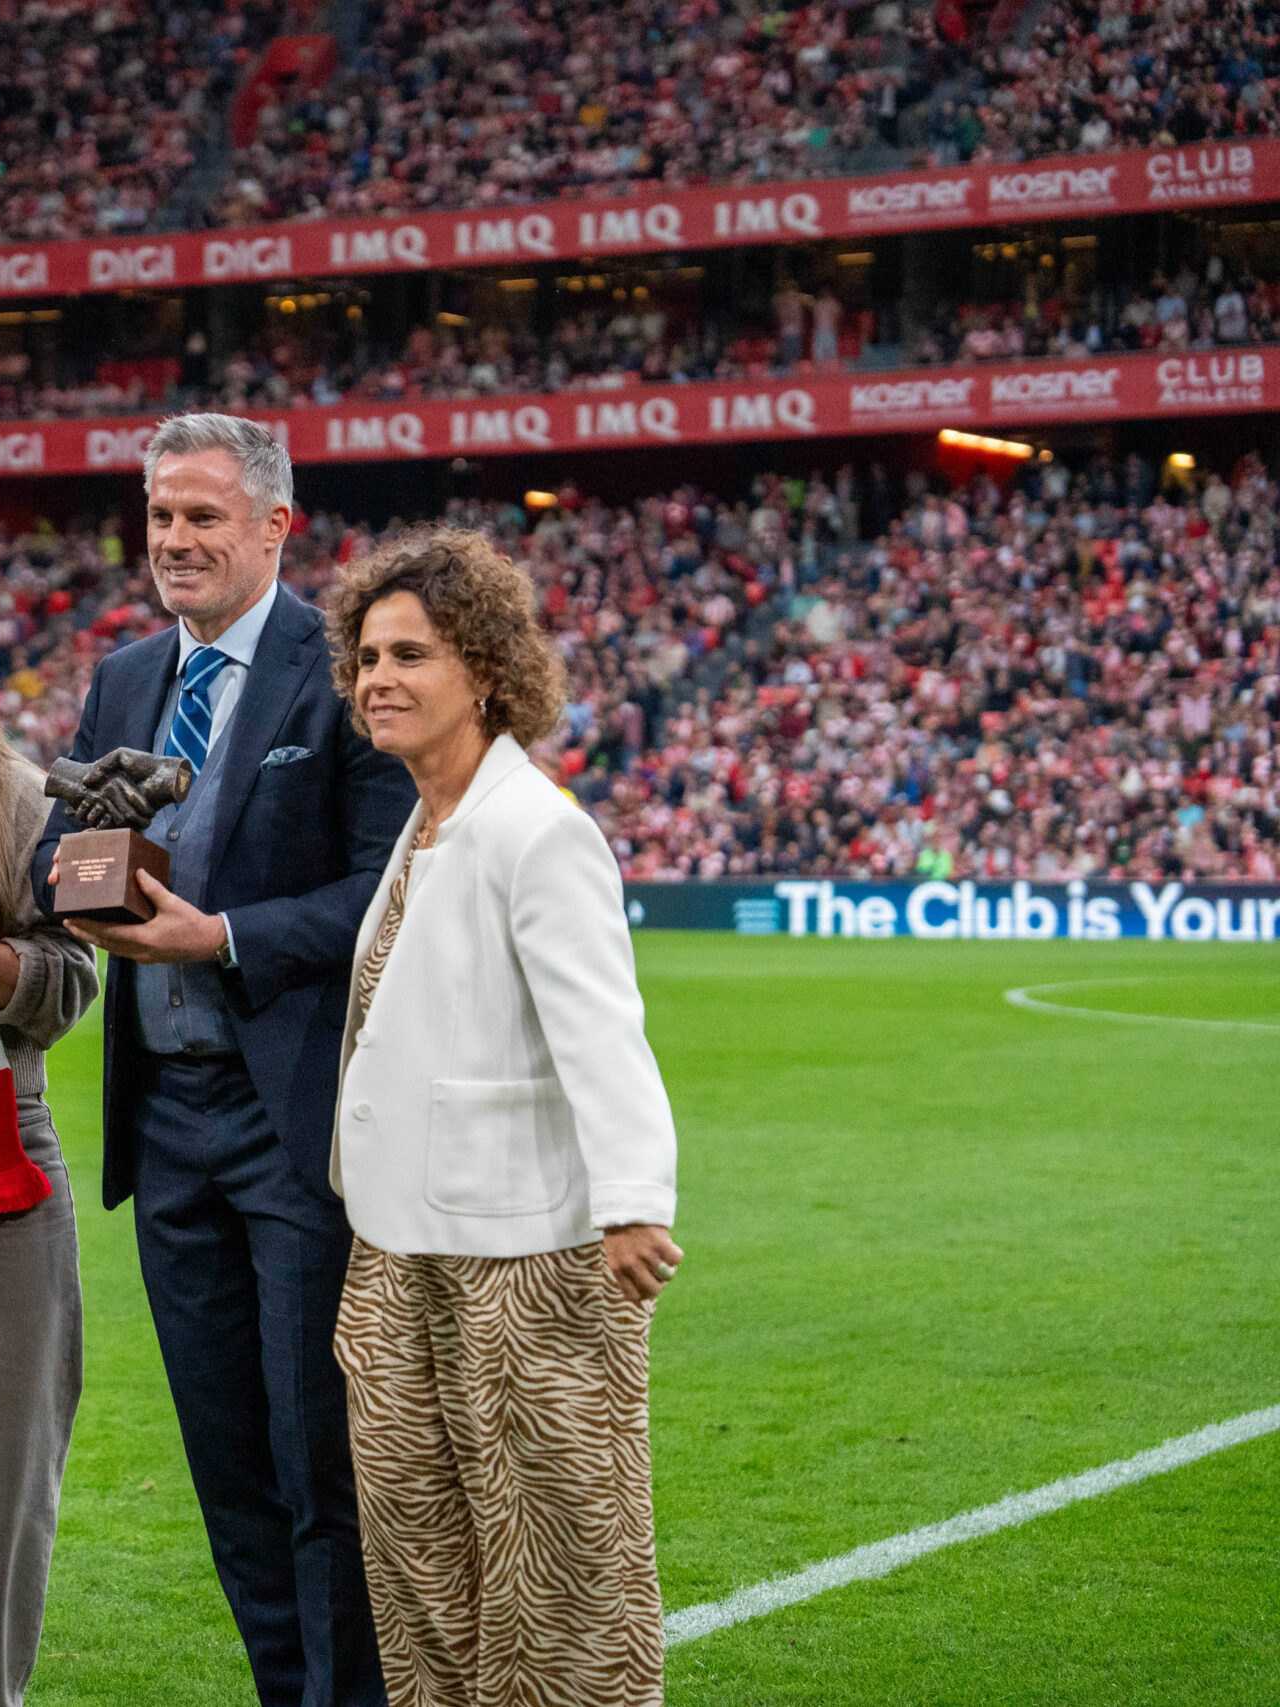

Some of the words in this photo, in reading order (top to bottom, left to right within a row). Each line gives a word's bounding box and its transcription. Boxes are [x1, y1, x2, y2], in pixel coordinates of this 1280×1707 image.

[1146, 145, 1255, 182] CLUB
[455, 213, 557, 256] IMQ
[579, 203, 684, 247] IMQ
[715, 192, 822, 236] IMQ
[88, 244, 177, 286] DIGI
[203, 236, 293, 277] DIGI
[330, 225, 430, 267] IMQ
[1156, 354, 1265, 386] CLUB
[449, 405, 552, 449] IMQ
[575, 397, 681, 442] IMQ
[709, 389, 816, 434] IMQ
[85, 428, 153, 469] DIG
[326, 413, 426, 456] IMQ
[776, 880, 898, 938] The
[905, 880, 1059, 939] Club
[1066, 879, 1122, 938] is
